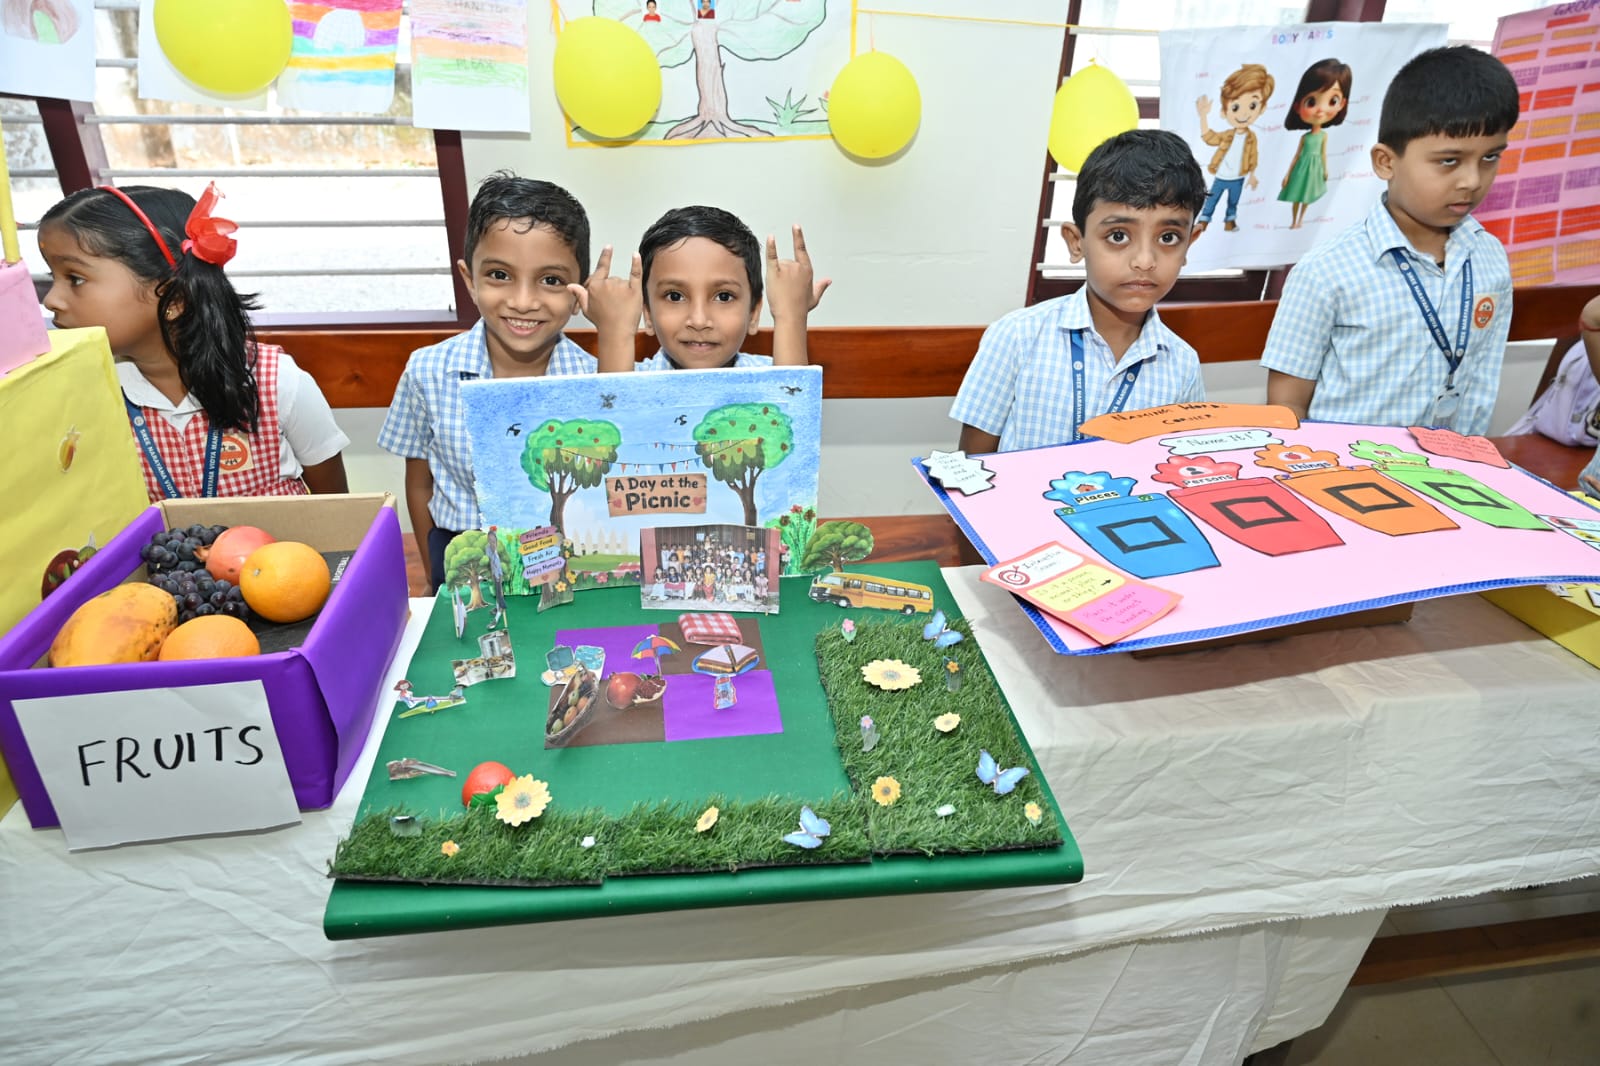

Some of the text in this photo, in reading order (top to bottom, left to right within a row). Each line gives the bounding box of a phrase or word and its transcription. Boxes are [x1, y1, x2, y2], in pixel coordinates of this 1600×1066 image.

[140, 428, 178, 498] SREE NARAYANA VIDYA
[209, 451, 217, 470] VIDYA
[1288, 460, 1332, 472] Things
[614, 476, 699, 492] A Day at the
[1182, 473, 1234, 487] Persons
[625, 491, 691, 511] Picnic
[1074, 490, 1120, 504] Places
[526, 529, 549, 539] Friends
[523, 538, 553, 551] Good Food
[528, 554, 543, 562] Fresh
[526, 561, 562, 576] Happy Moments
[78, 725, 264, 787] FRUITS
